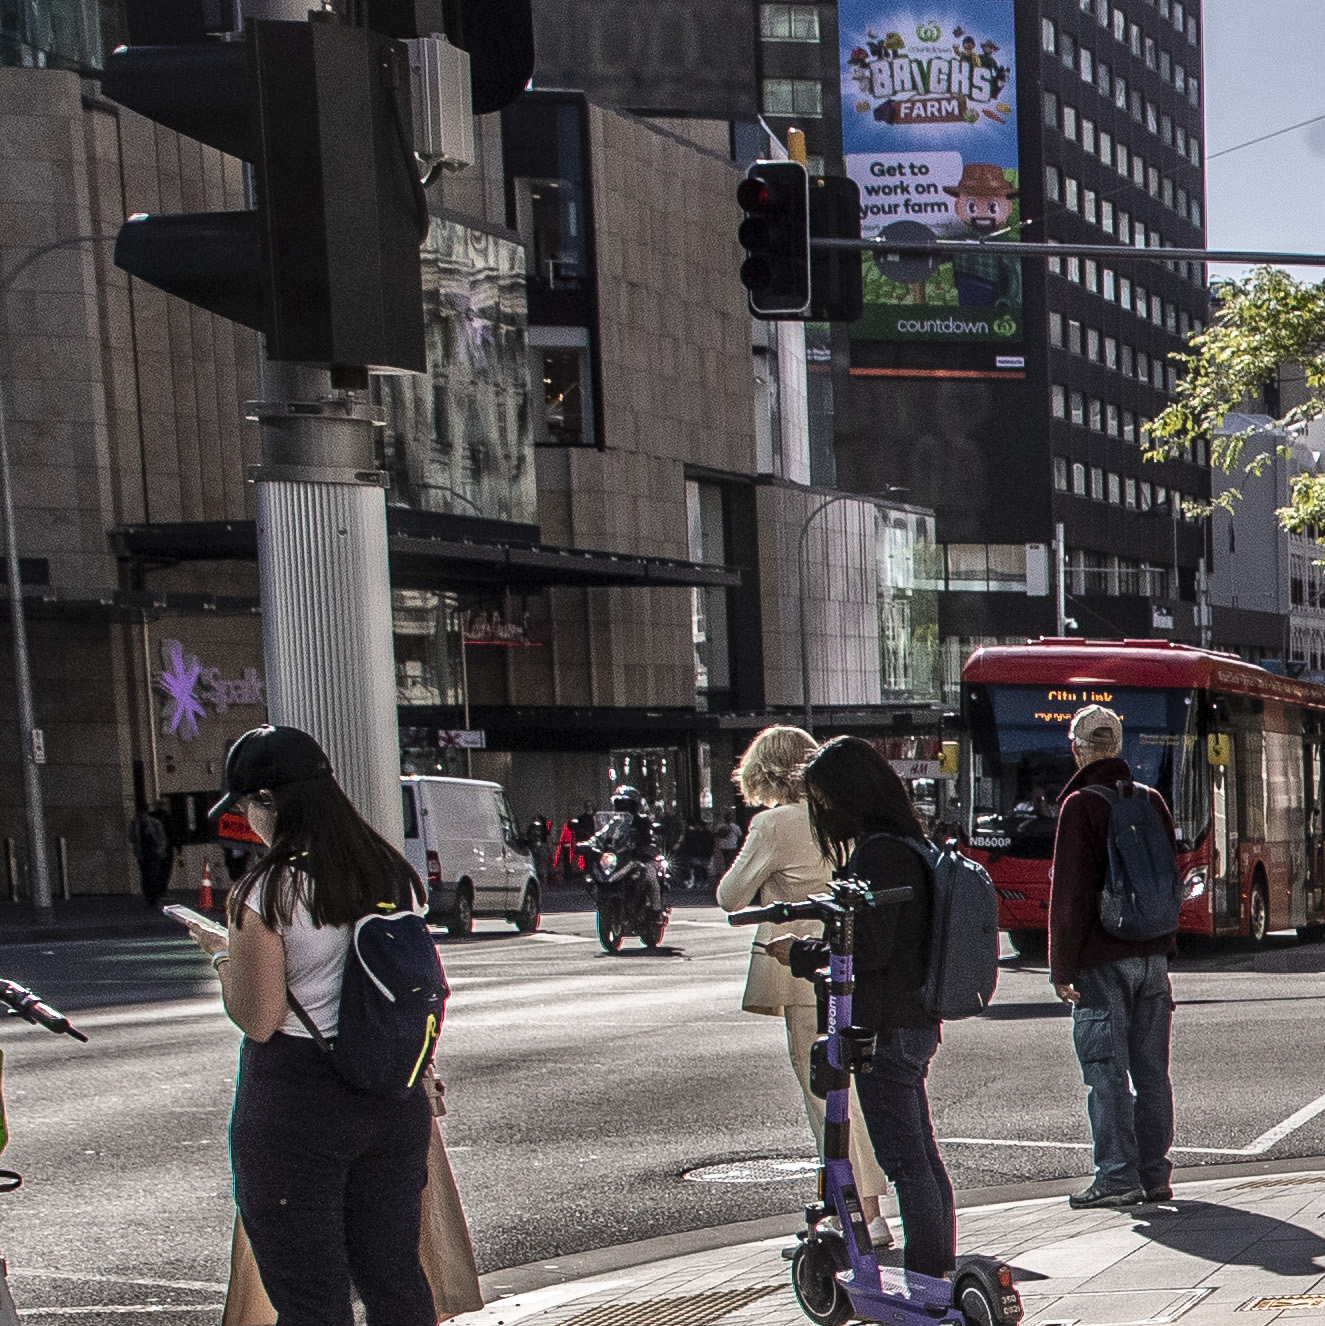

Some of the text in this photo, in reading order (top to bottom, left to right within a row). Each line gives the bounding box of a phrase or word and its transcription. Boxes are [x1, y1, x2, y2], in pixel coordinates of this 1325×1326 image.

[869, 57, 992, 103] BRICKS
[900, 101, 959, 118] FARM
[870, 162, 930, 177] Get to
[864, 180, 939, 196] work on
[860, 198, 949, 220] your farm
[897, 317, 989, 335] countdown
[828, 994, 837, 1035] beam
